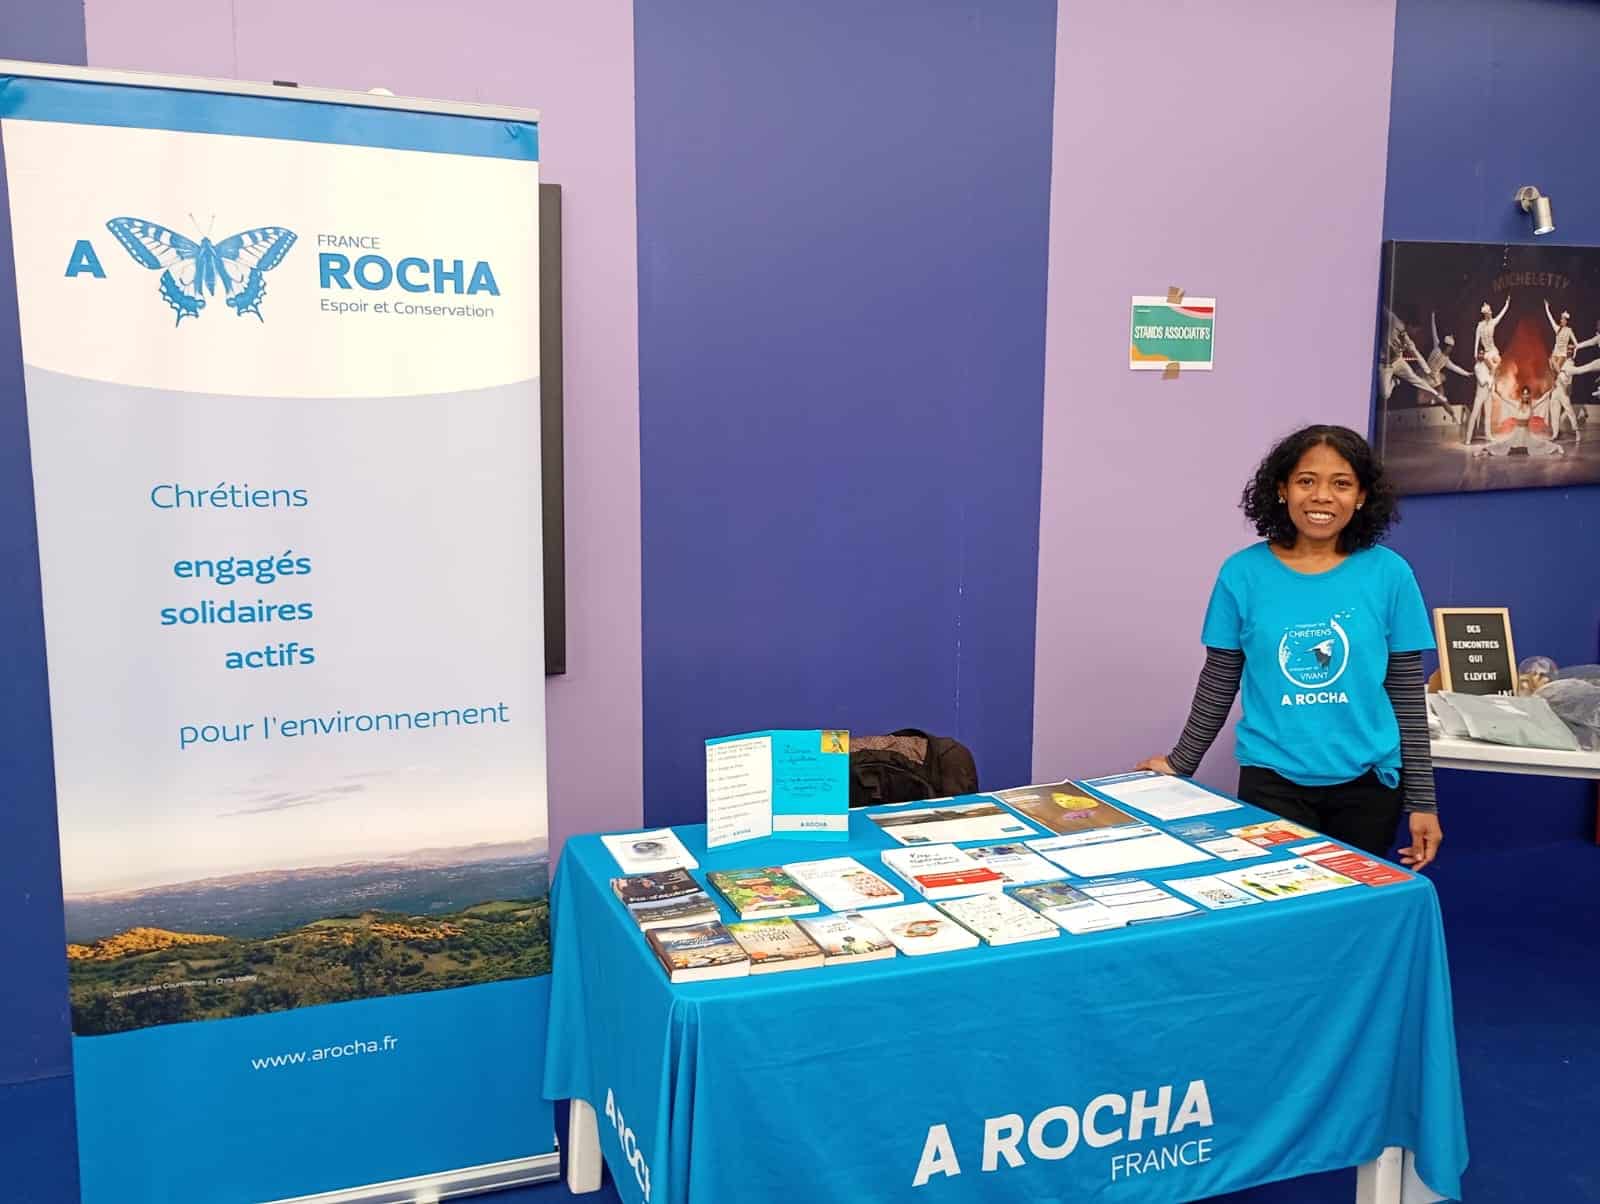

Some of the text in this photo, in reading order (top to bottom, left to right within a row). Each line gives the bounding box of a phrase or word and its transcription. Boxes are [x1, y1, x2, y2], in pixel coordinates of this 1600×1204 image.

[317, 234, 380, 250] FRANCE
[65, 240, 501, 296] A ROCHA
[320, 298, 495, 318] Espoir et Conservation
[1135, 326, 1210, 340] STANDS ASSOCIATIFS
[151, 482, 309, 508] Chrétiens
[173, 550, 312, 585] engagés
[160, 599, 313, 625] solidaires
[1466, 625, 1481, 634] DES
[224, 641, 316, 669] actifs
[1452, 640, 1499, 649] RENCONTRES
[1468, 654, 1483, 663] QUI
[1300, 672, 1328, 681] VIVANT
[1281, 692, 1349, 706] A ROCHA
[179, 702, 510, 750] pour l'environnement
[251, 1035, 398, 1070] www.arocha.fr
[605, 1087, 617, 1129] A
[912, 1079, 1214, 1187] A ROCHA
[1111, 1138, 1214, 1181] FRANCE
